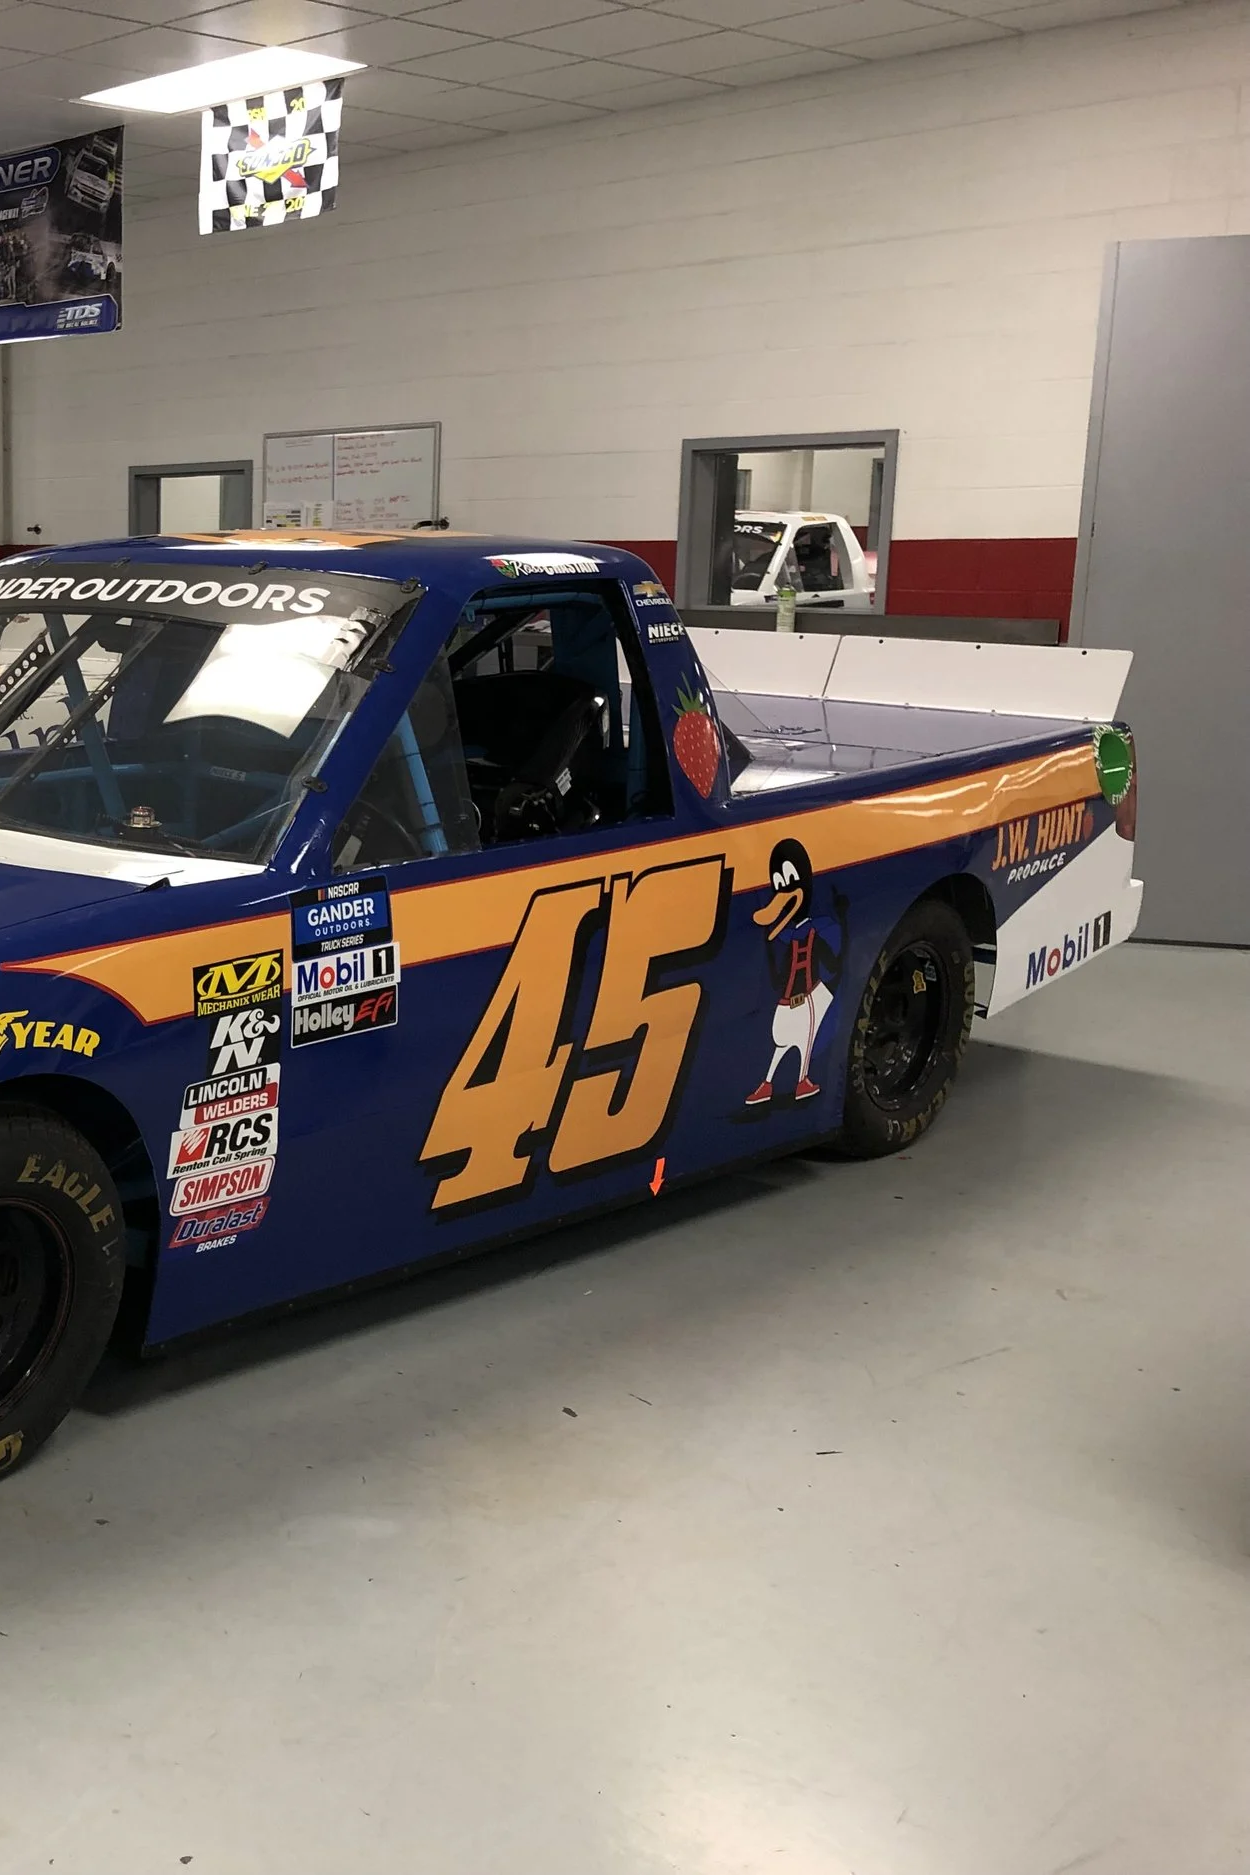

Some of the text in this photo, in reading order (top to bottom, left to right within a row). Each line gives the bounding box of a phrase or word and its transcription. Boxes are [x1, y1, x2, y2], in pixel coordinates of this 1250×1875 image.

[241, 142, 307, 173] SUNOCO
[648, 622, 686, 639] NIECE
[992, 801, 1086, 872] J.W. HUNT
[1006, 851, 1067, 885] PRODUCE
[327, 881, 360, 900] NASCAR
[307, 897, 375, 927] GANDER
[315, 918, 370, 937] OUTDOORS
[1026, 922, 1090, 990] Mobil
[297, 952, 364, 995] Mobil
[297, 992, 321, 1003] OFFICIAL
[322, 988, 345, 998] MOTOR
[345, 986, 355, 994] OIL
[360, 976, 395, 989] LUBRICANTS
[197, 983, 281, 1017] MECHANIX WEAR
[294, 991, 394, 1035] Holley EFI
[418, 855, 730, 1211] 45
[188, 1071, 264, 1107] LINCOLN
[203, 1092, 269, 1121] WELDERS
[204, 1112, 273, 1159] RCS
[172, 1146, 268, 1175] Renton Coil Spring
[17, 1153, 116, 1233] EAGLE
[179, 1164, 266, 1208] SIMPSON
[175, 1203, 262, 1242] Duralast
[195, 1234, 238, 1253] BRAKES
